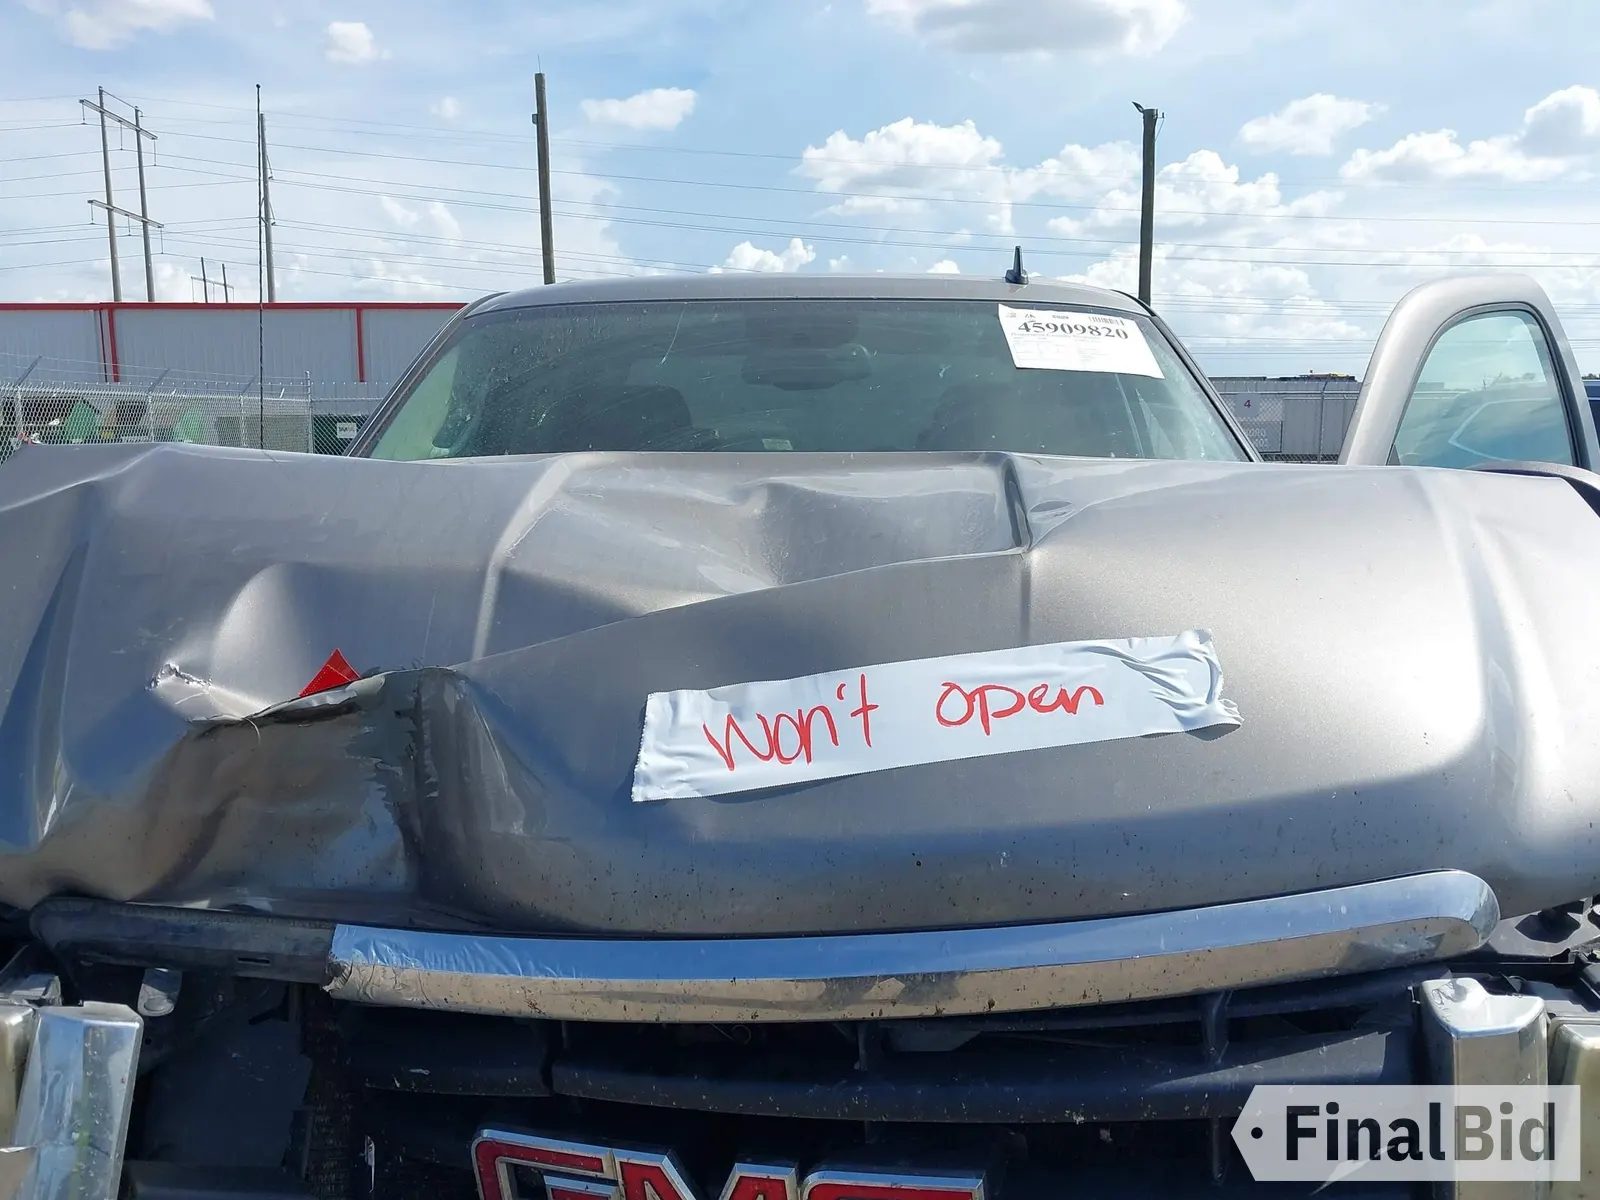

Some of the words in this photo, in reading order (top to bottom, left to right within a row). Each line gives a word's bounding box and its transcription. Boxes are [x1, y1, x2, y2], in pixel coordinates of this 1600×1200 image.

[1018, 321, 1129, 340] 45909820
[1243, 399, 1252, 409] 4
[935, 681, 1106, 736] open
